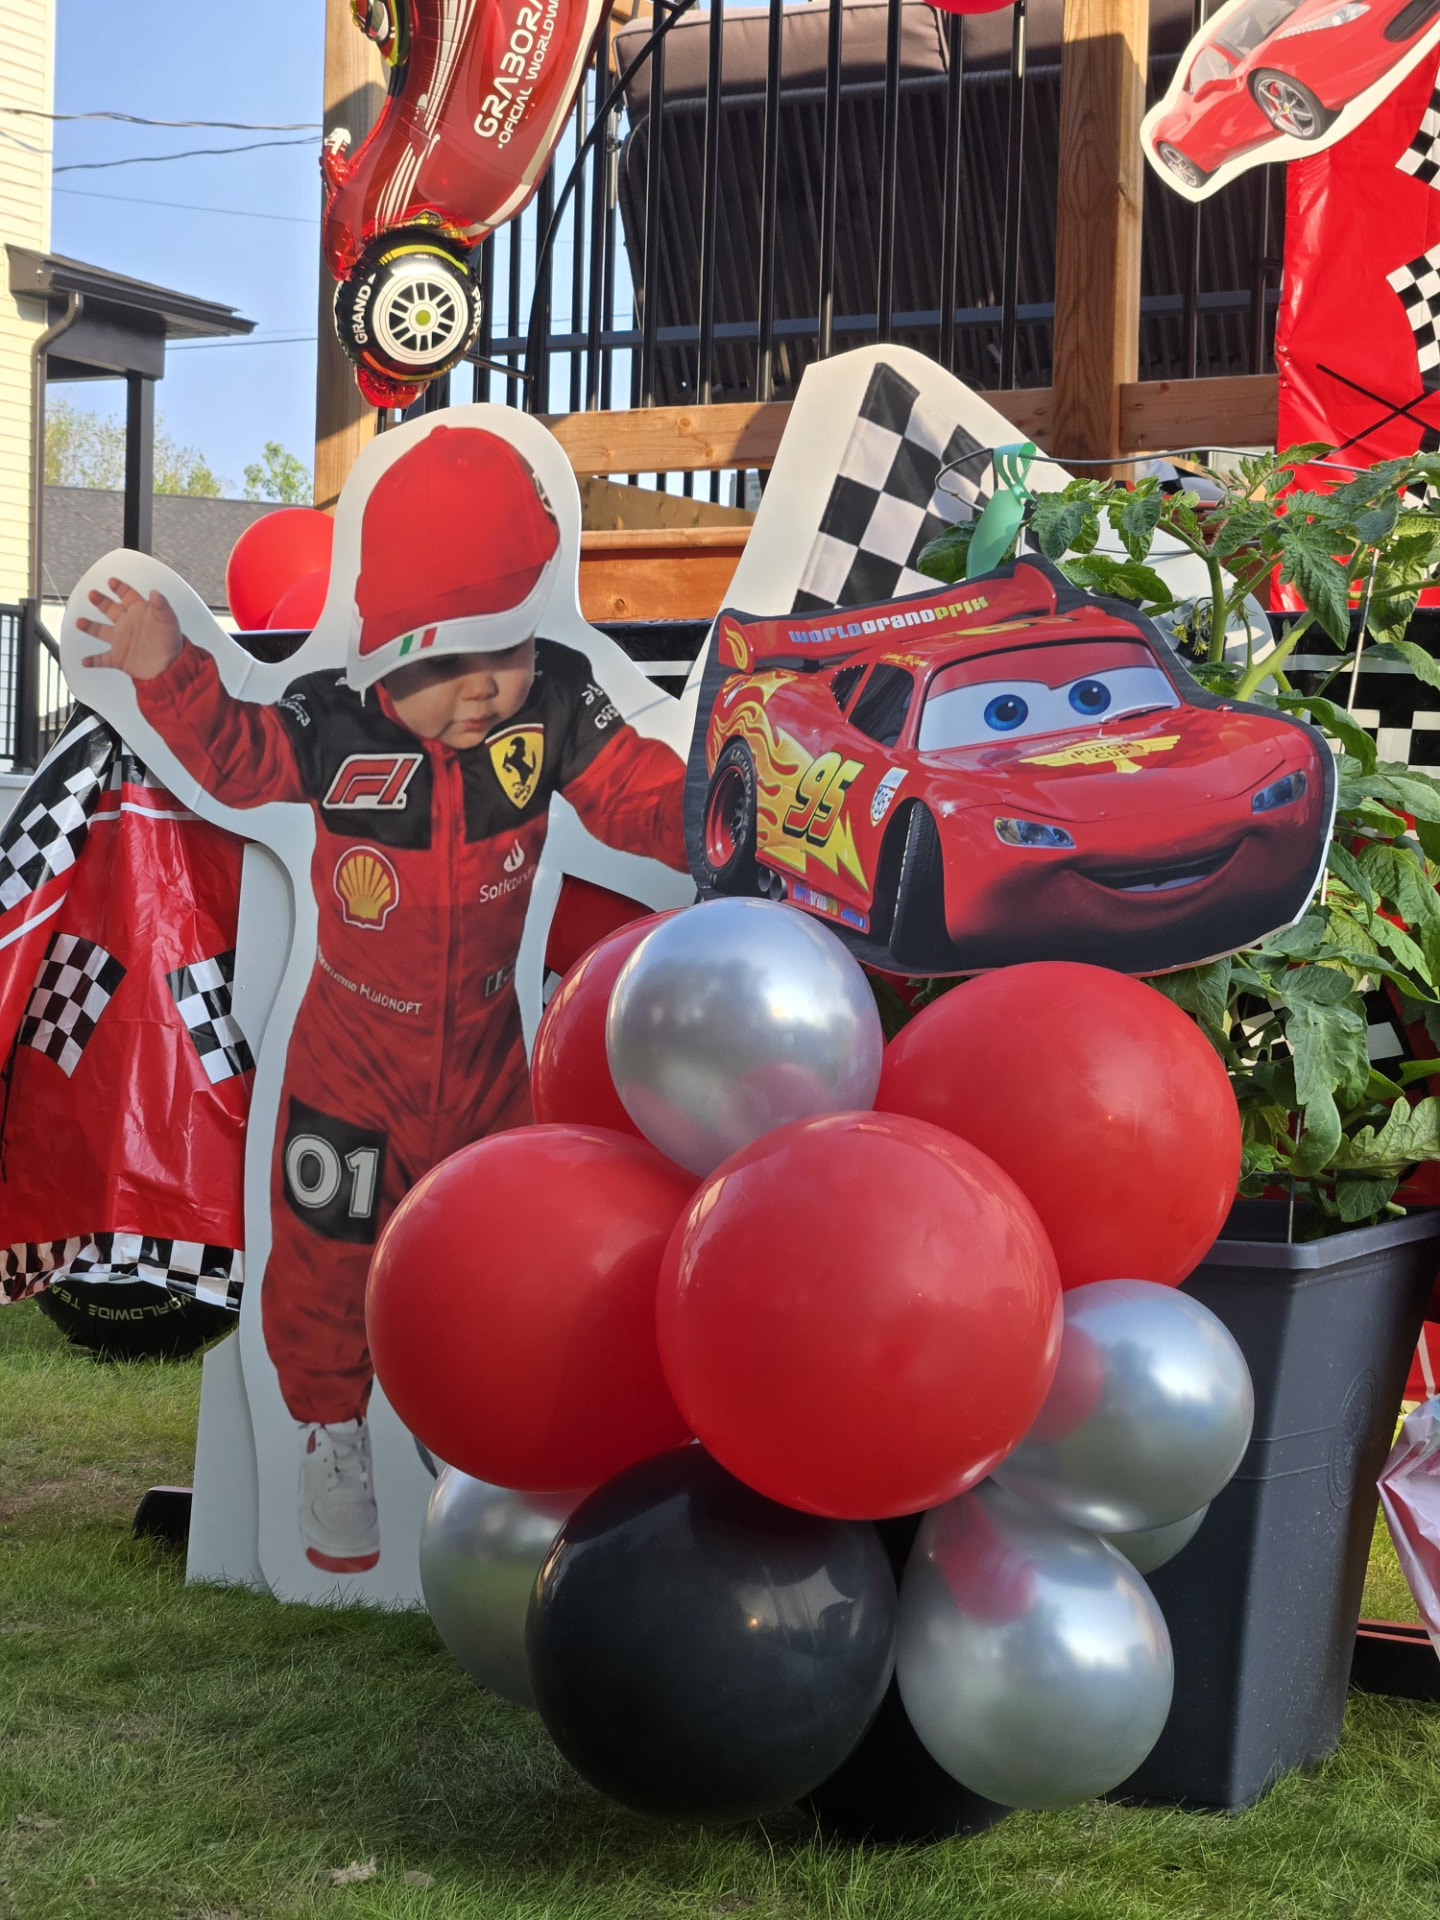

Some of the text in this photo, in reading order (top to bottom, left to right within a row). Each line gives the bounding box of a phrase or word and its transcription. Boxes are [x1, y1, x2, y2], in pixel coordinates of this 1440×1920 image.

[351, 284, 482, 344] GRAND PRIX
[1077, 742, 1134, 757] PISTON
[1095, 748, 1131, 760] CUP
[322, 753, 424, 809] F1
[782, 751, 865, 848] 95
[286, 1133, 380, 1219] 01
[48, 1285, 194, 1320] WORLDWIDE TEA
